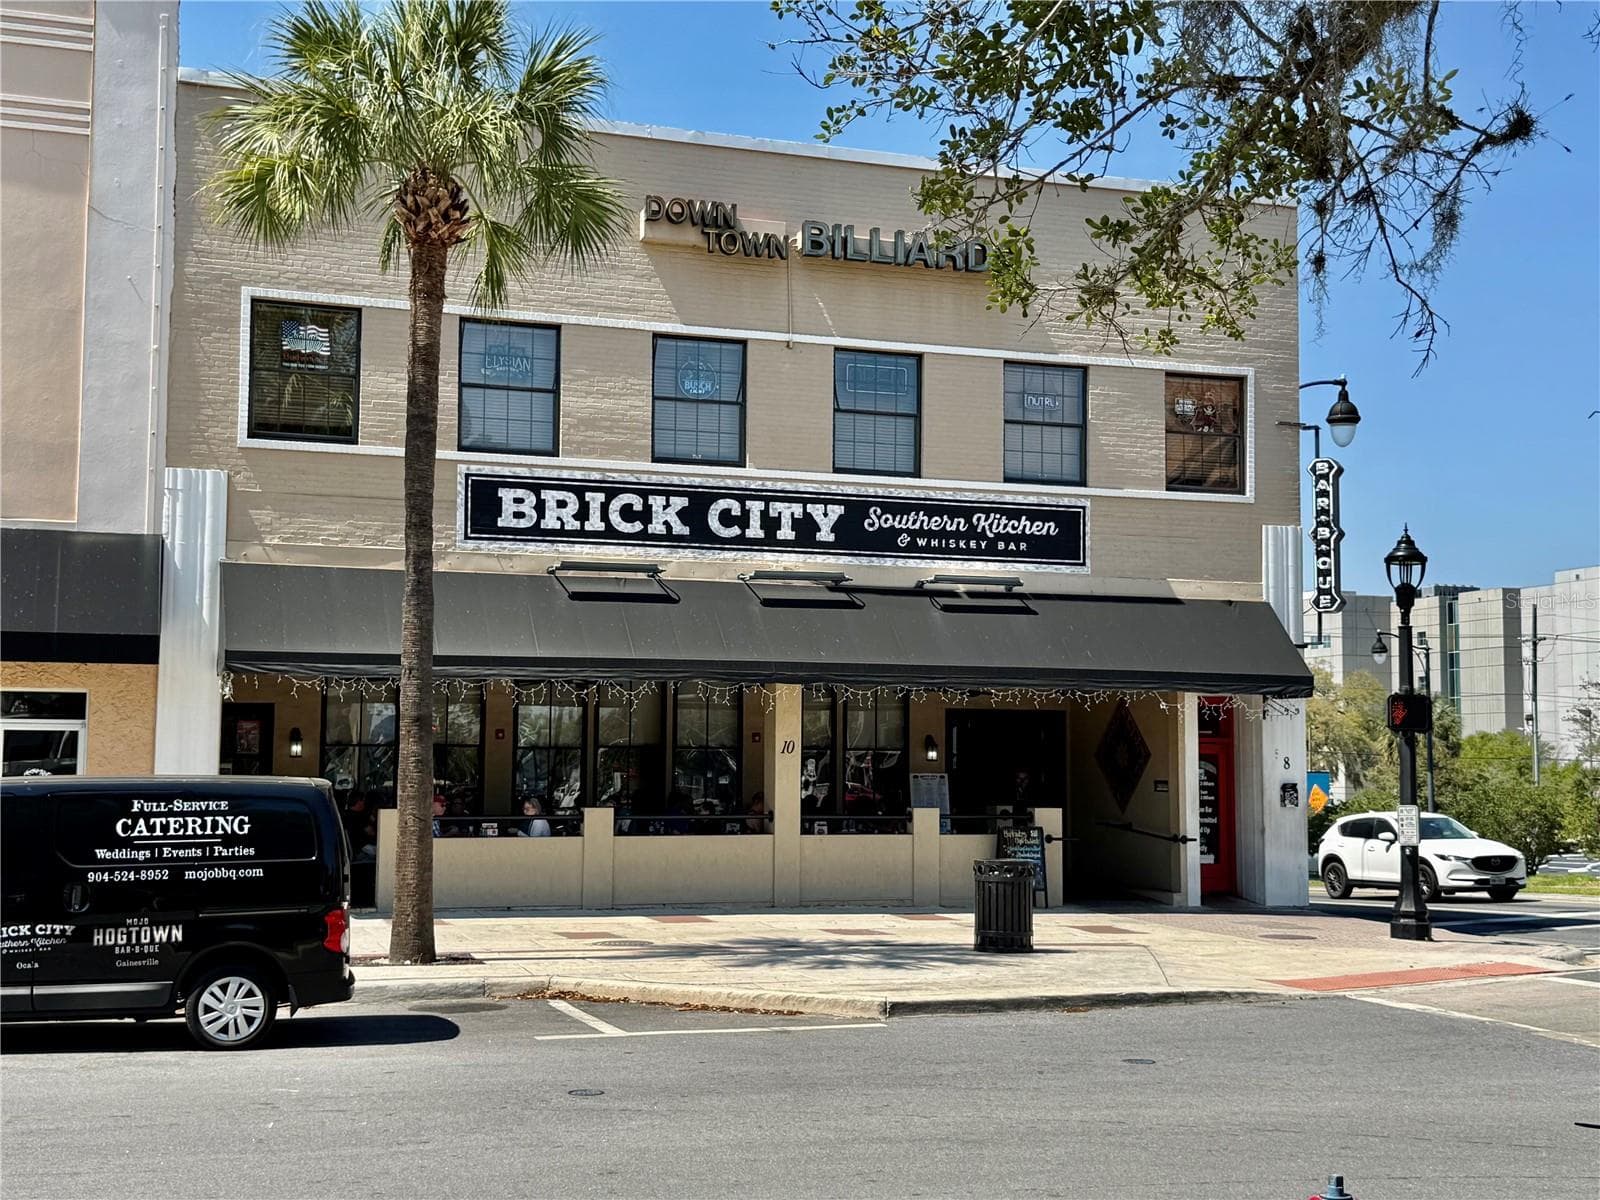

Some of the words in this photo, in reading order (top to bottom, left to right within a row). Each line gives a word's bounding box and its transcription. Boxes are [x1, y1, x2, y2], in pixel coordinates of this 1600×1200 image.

[645, 194, 738, 229] DOWN
[703, 226, 790, 260] TOWN
[485, 355, 531, 372] ELYSIAN
[496, 487, 690, 536] BRICK
[708, 497, 846, 542] CITY
[863, 506, 969, 532] Southern
[972, 512, 1059, 538] Kitchen
[897, 533, 911, 547] &
[916, 537, 988, 550] WHISKEY
[997, 541, 1028, 551] BAR
[780, 740, 795, 754] 10
[1283, 756, 1291, 770] 8
[131, 799, 229, 812] FULL-SERVICE
[115, 815, 252, 837] CATERING
[94, 848, 151, 861] Weddings
[162, 846, 202, 858] Events
[213, 845, 255, 857] Parties
[87, 869, 169, 883] 904-524-8952
[184, 867, 264, 882] mojobbq.com
[126, 917, 149, 926] MOJO
[0, 924, 32, 938] ICK
[35, 923, 76, 936] CITY
[93, 924, 183, 947] HOGTOWN
[30, 937, 67, 948] Kitchen
[115, 958, 160, 968] Gainesville
